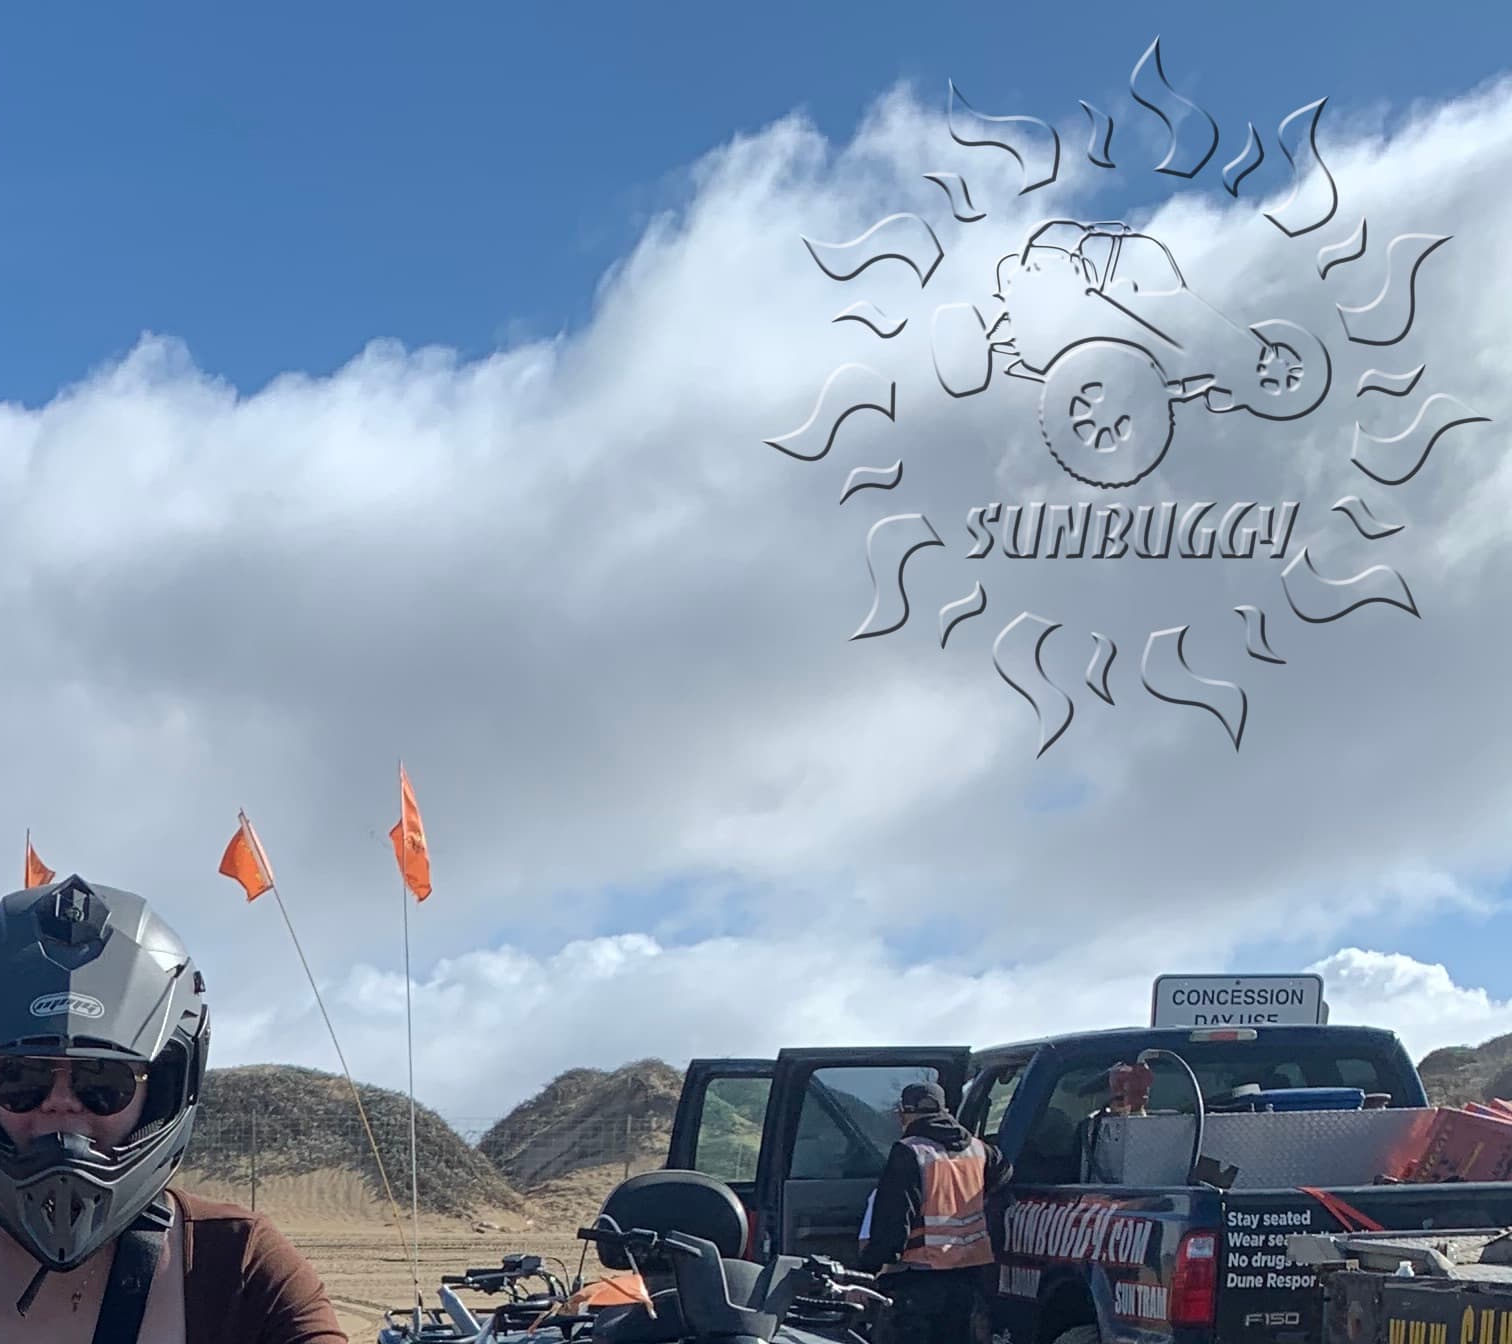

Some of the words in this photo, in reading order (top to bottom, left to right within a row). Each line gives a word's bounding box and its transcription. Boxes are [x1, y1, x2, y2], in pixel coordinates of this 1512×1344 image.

[1172, 988, 1304, 1006] CONCESSION
[1227, 1211, 1260, 1229] Stay
[1263, 1210, 1311, 1226] seated
[1004, 1201, 1153, 1265] SUNBUGGY.COM
[1227, 1232, 1265, 1247] Wear
[1228, 1253, 1248, 1268] No
[1227, 1273, 1263, 1288] Dune
